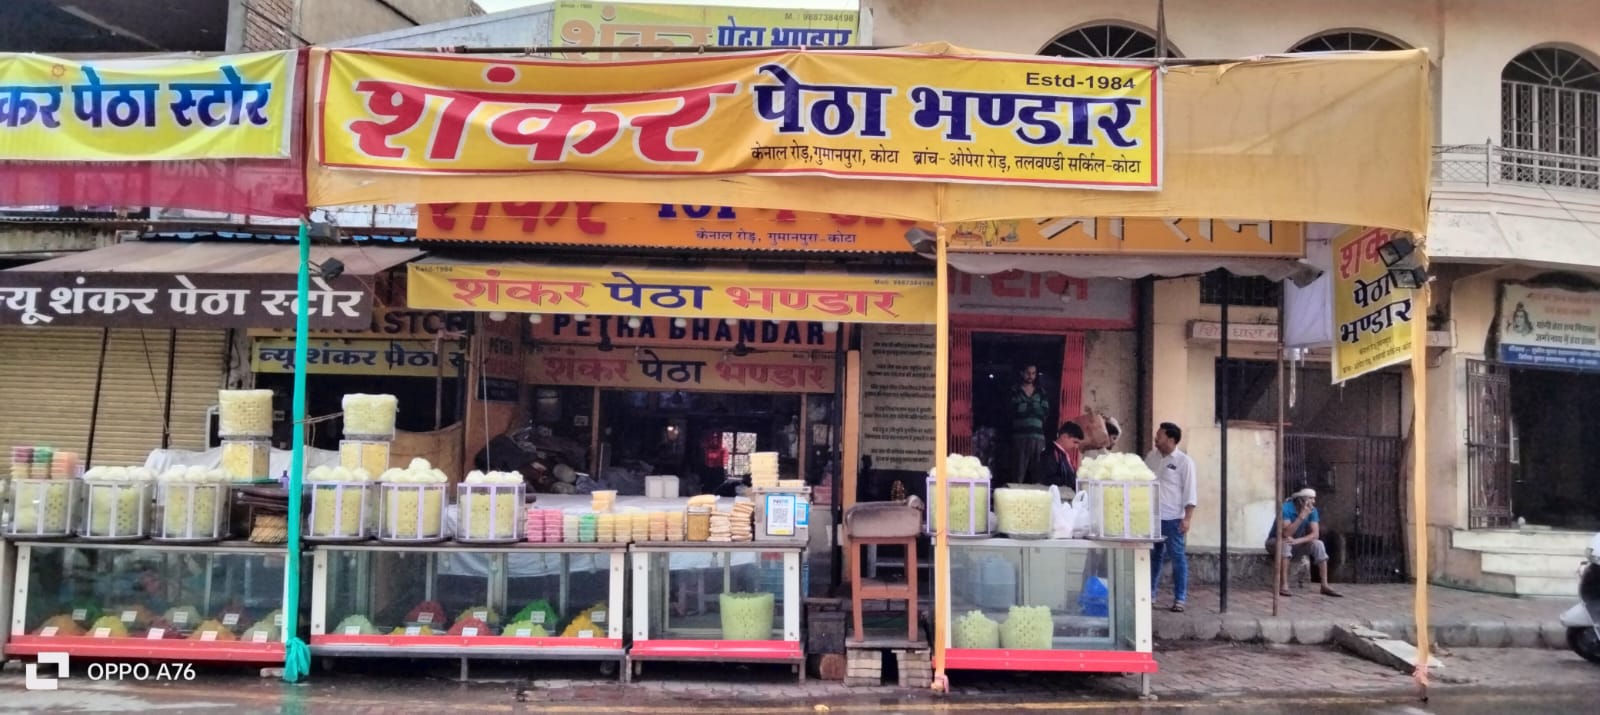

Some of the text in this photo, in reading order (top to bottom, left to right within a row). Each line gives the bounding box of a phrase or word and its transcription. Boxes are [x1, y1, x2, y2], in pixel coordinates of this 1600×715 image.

[72, 65, 160, 128] पेठा
[168, 65, 271, 127] स्टोर
[1026, 72, 1136, 90] Estd-1984
[349, 64, 1141, 162] शंकर पेठा भण्डार
[751, 142, 787, 161] केनाल
[870, 144, 899, 164] कोटा
[949, 148, 984, 168] ओपेरा
[1014, 152, 1064, 171] तलवण्डी
[696, 228, 733, 241] केनाल
[49, 276, 158, 315] शंकर
[168, 275, 250, 315] पेठा
[261, 277, 364, 317] स्टोर
[448, 268, 904, 318] शंकर पेठा भण्डार
[1353, 273, 1391, 308] पेठा
[553, 313, 825, 345] PETHA BHANDAR
[1340, 298, 1411, 343] भण्डार
[306, 342, 377, 366] शंकर
[543, 353, 632, 384] शंकर
[637, 350, 707, 384] पेठा
[715, 361, 828, 389] भण्डार
